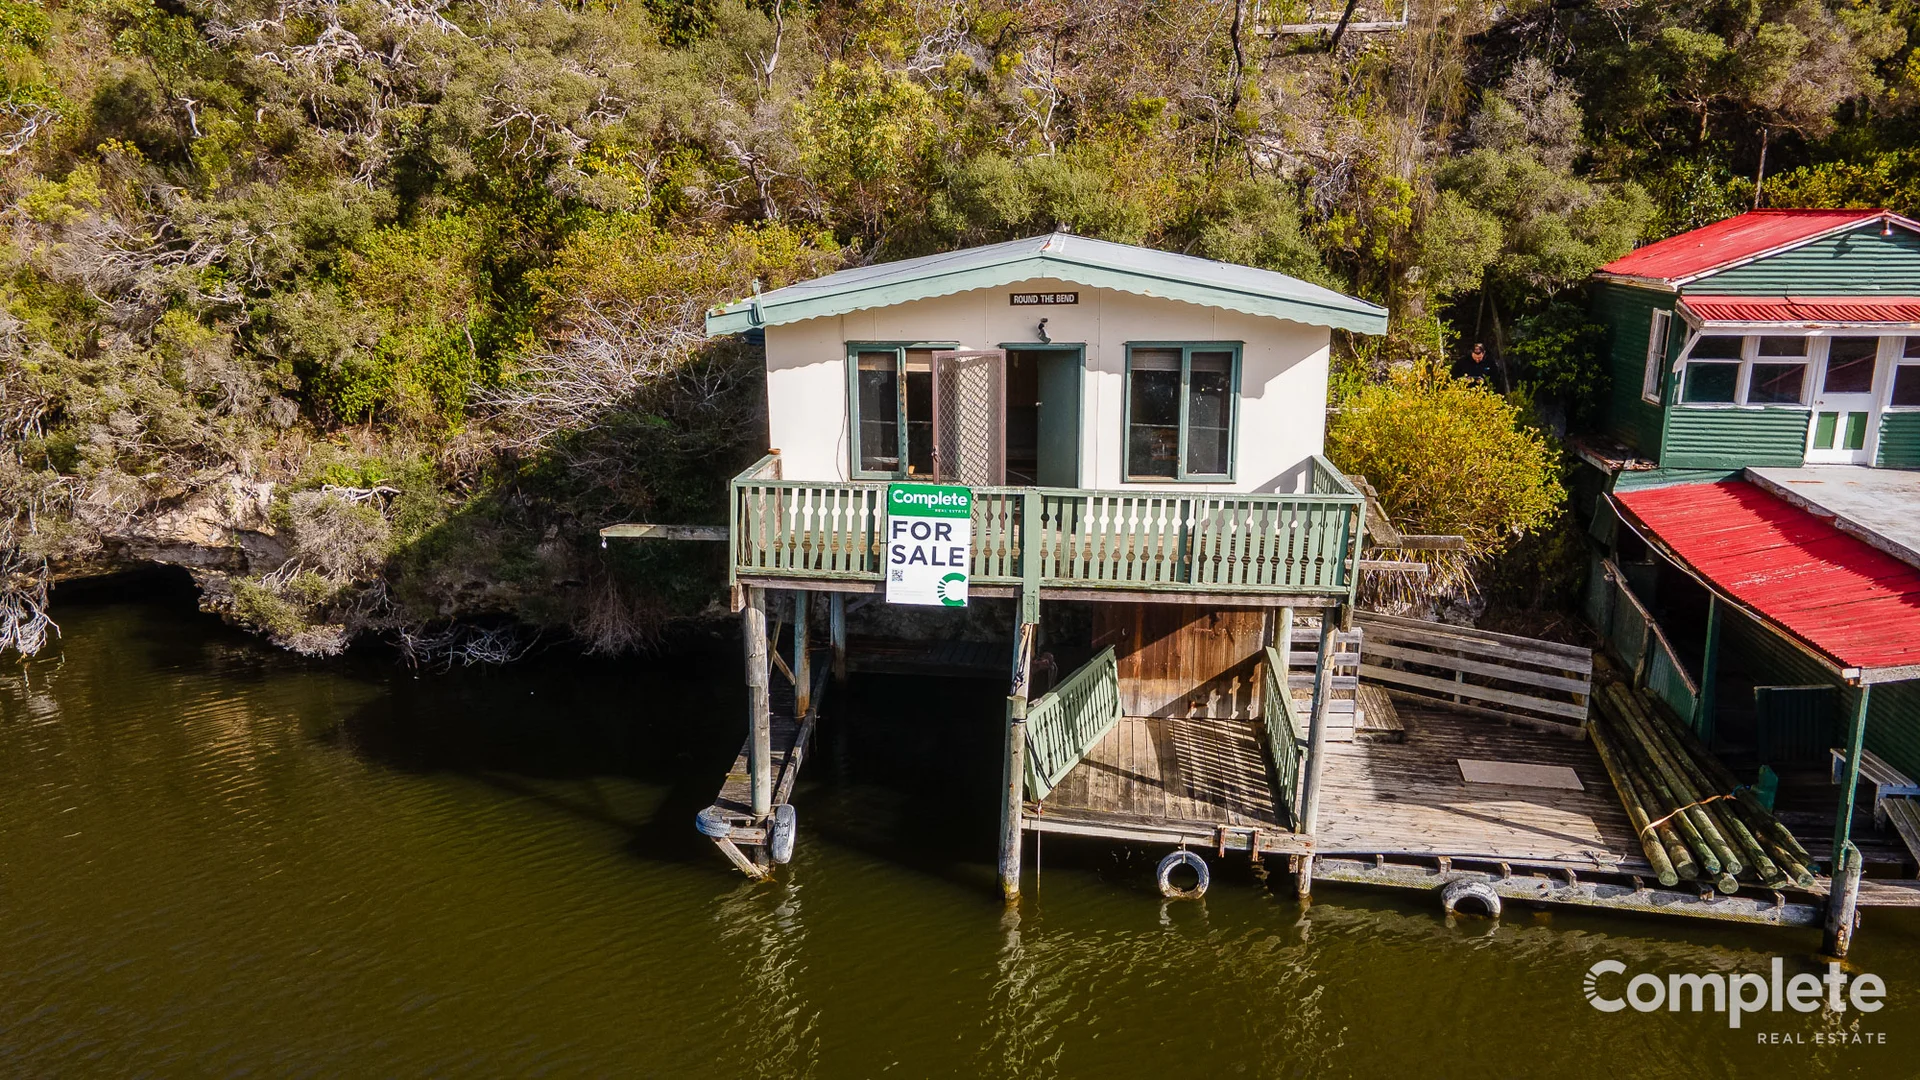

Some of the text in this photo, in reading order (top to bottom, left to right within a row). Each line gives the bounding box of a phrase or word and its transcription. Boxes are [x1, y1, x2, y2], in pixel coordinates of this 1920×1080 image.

[1013, 294, 1075, 304] ROUND THE BEND
[892, 489, 968, 509] Complete
[892, 520, 952, 542] FOR
[891, 544, 965, 567] SALE
